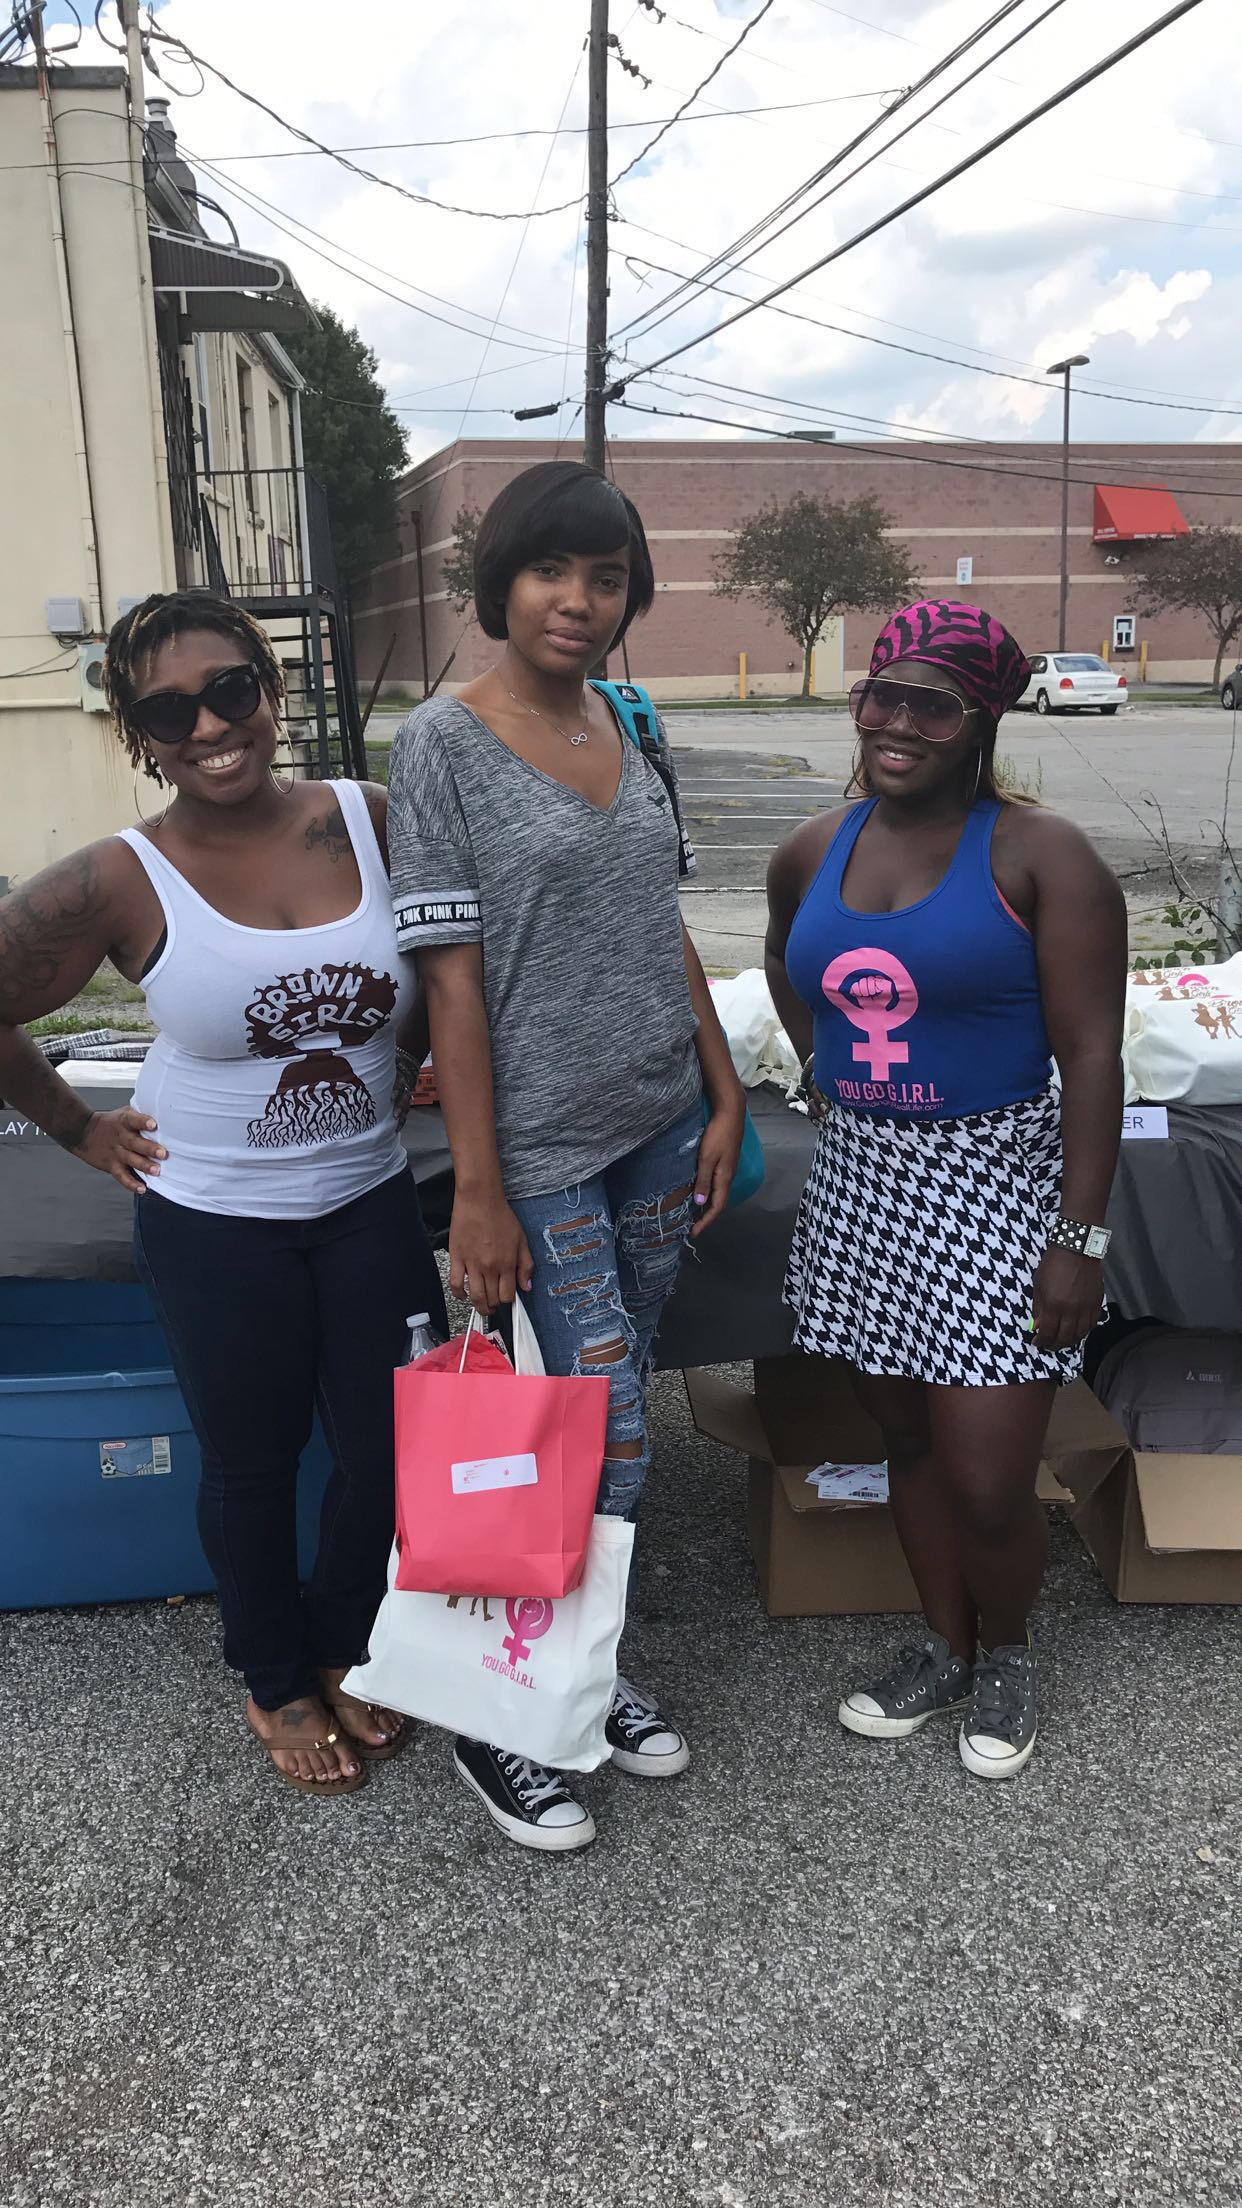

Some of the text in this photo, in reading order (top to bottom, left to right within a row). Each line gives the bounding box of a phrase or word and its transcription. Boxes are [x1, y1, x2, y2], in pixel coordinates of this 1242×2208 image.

[424, 904, 453, 921] PINK
[249, 972, 363, 1024] BROWN
[267, 1000, 386, 1043] GIRLS
[834, 1078, 945, 1104] YOU GO G.I.R.L.
[481, 1653, 500, 1672] YOU
[499, 1660, 511, 1677] GO
